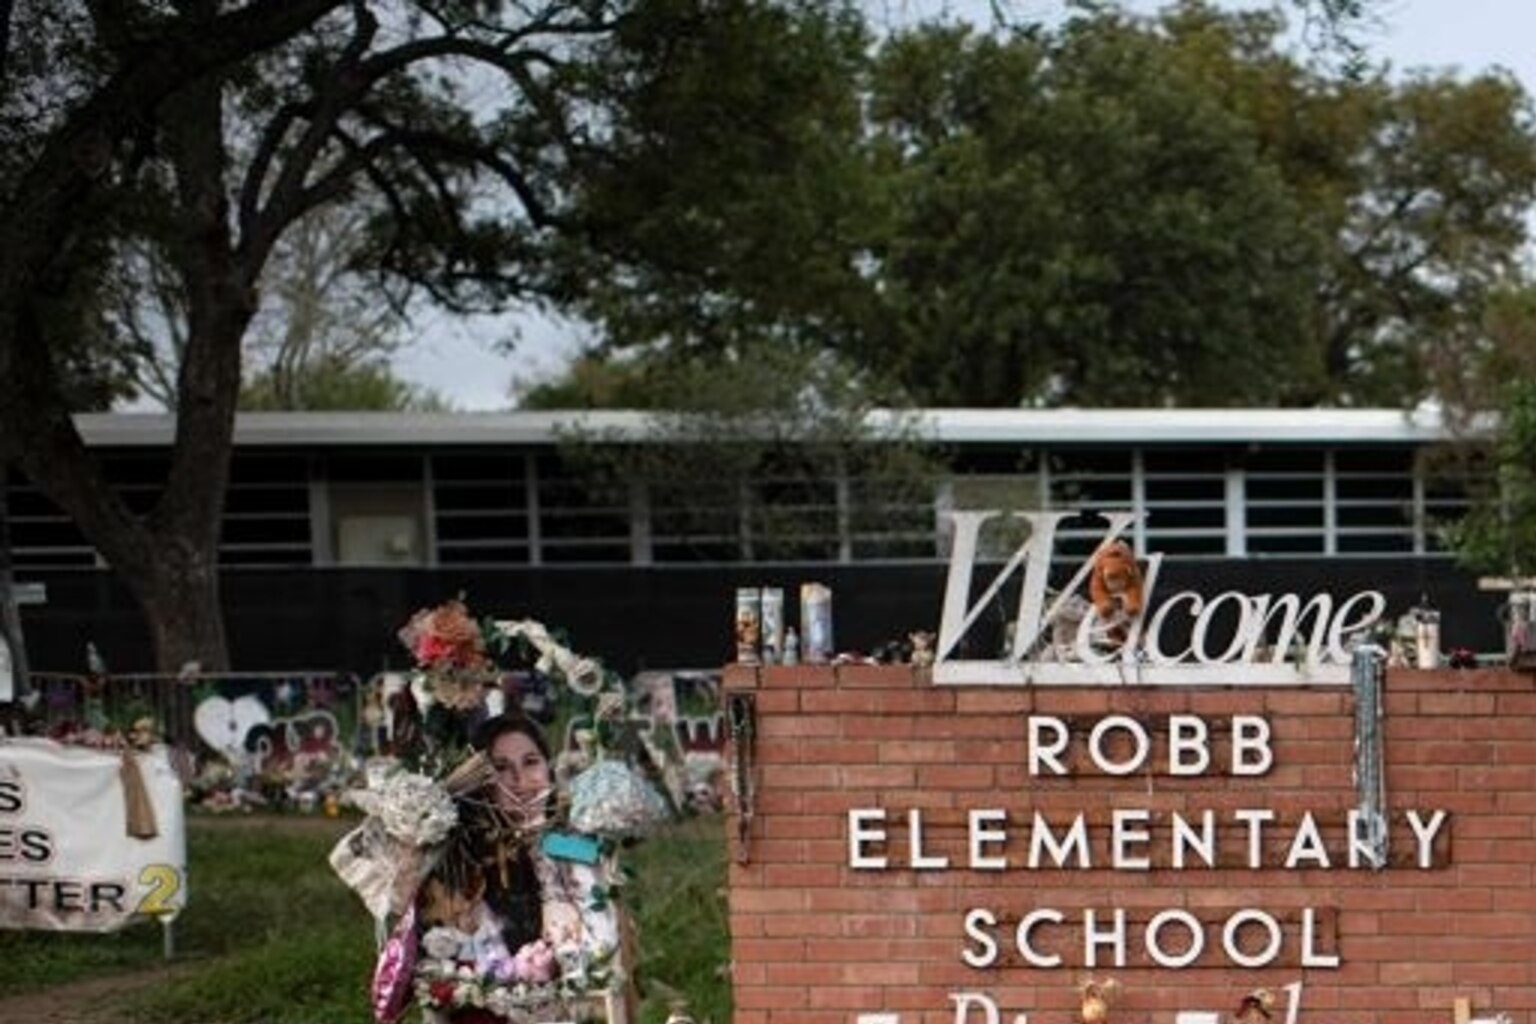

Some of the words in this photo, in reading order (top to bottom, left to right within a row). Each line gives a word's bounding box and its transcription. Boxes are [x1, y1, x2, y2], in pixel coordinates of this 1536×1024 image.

[936, 511, 1386, 666] Welcome
[1028, 715, 1275, 777] ROBB
[848, 808, 1448, 869] ELEMENTARY
[0, 877, 125, 912] TER
[137, 863, 181, 914] 2
[961, 908, 1341, 969] SCHOOL
